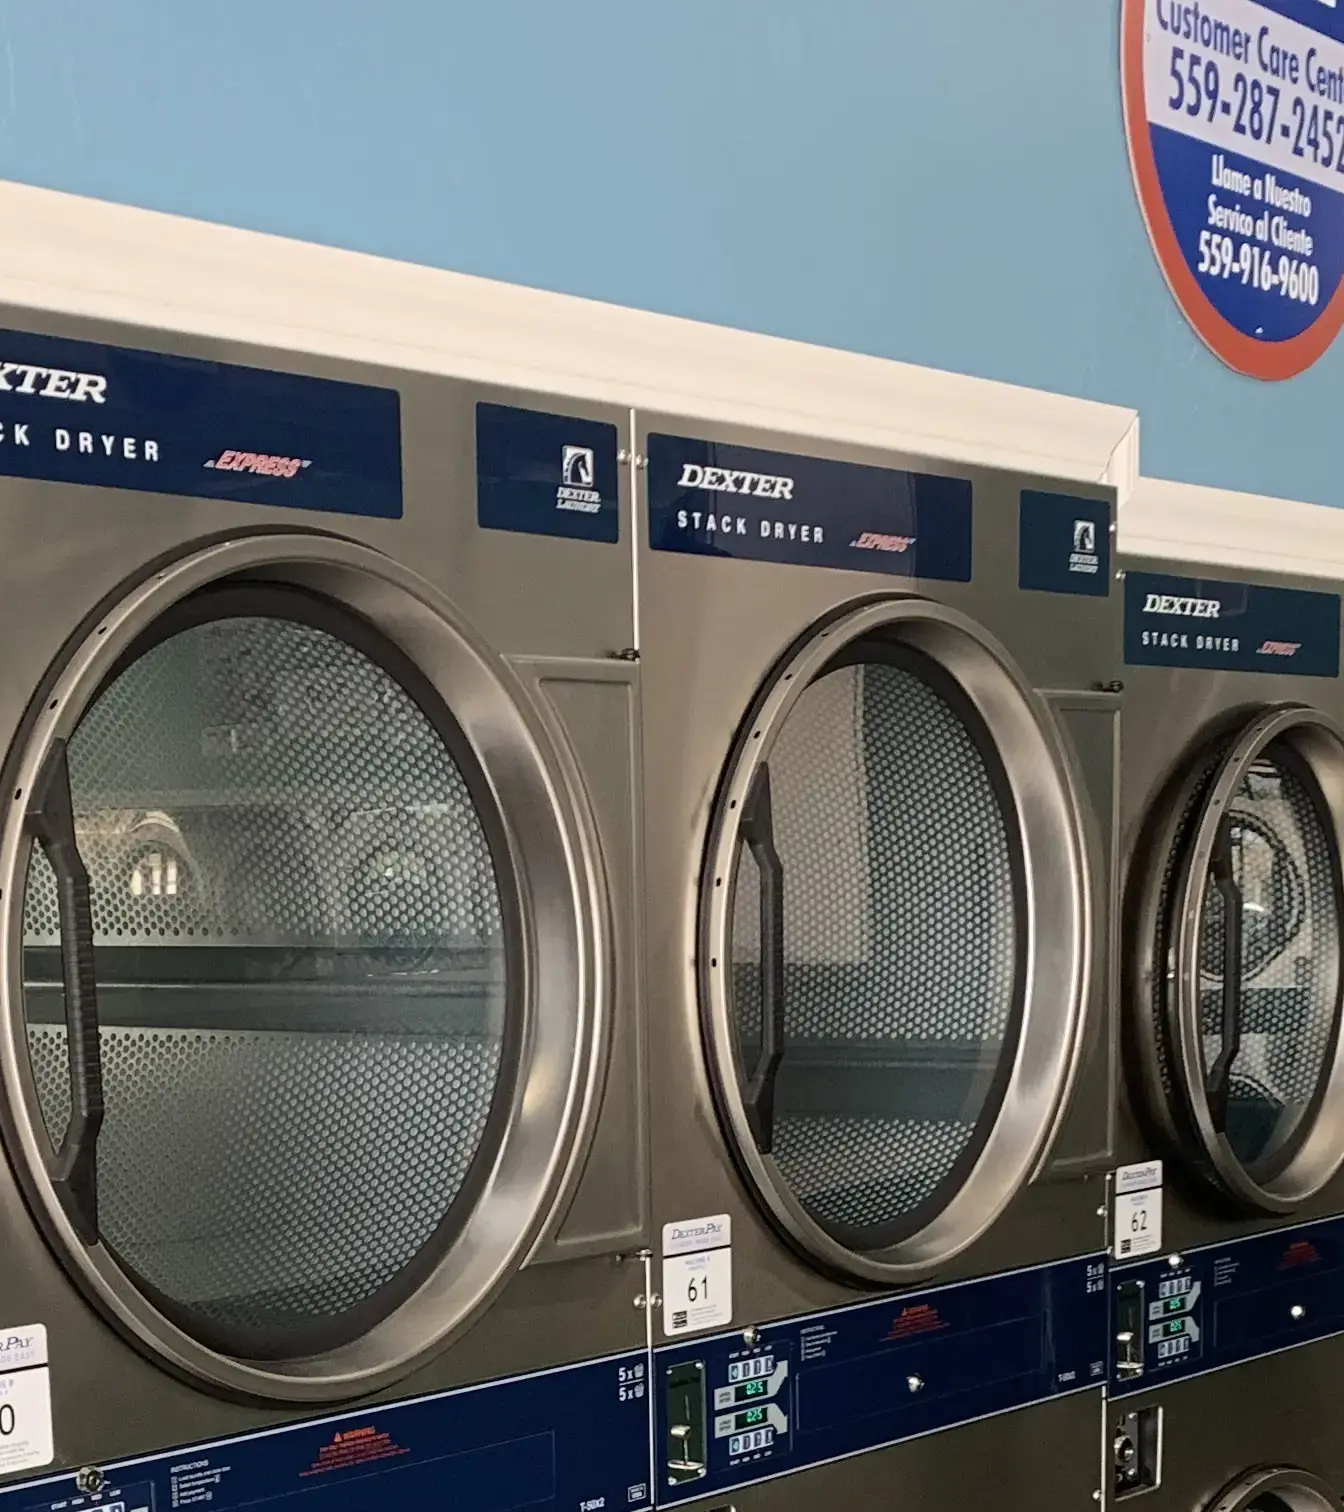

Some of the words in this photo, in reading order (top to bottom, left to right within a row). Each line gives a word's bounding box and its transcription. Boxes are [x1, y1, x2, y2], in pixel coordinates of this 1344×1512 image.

[1156, 0, 1251, 64] Customer
[1257, 25, 1299, 84] Care
[1212, 154, 1251, 196] Llame
[1253, 178, 1262, 200] a
[1265, 173, 1312, 217] Nuestro
[1208, 193, 1254, 237] Servico
[1256, 210, 1269, 241] al
[1271, 216, 1313, 256] Cliente
[1198, 230, 1319, 305] 559-916-9600
[56, 428, 159, 462] DRYER
[215, 449, 304, 478] EXPRESS
[677, 463, 795, 500] DEXTER
[677, 510, 747, 535] STACK
[760, 520, 824, 543] DRYER
[1142, 593, 1221, 618] DEXTER
[1141, 631, 1189, 649] STACK
[1196, 636, 1240, 652] DRYER
[1131, 1209, 1147, 1232] 62
[688, 1275, 707, 1302] 61
[618, 1367, 626, 1381] 5
[627, 1370, 633, 1380] x
[619, 1387, 627, 1401] 5
[627, 1390, 634, 1400] x
